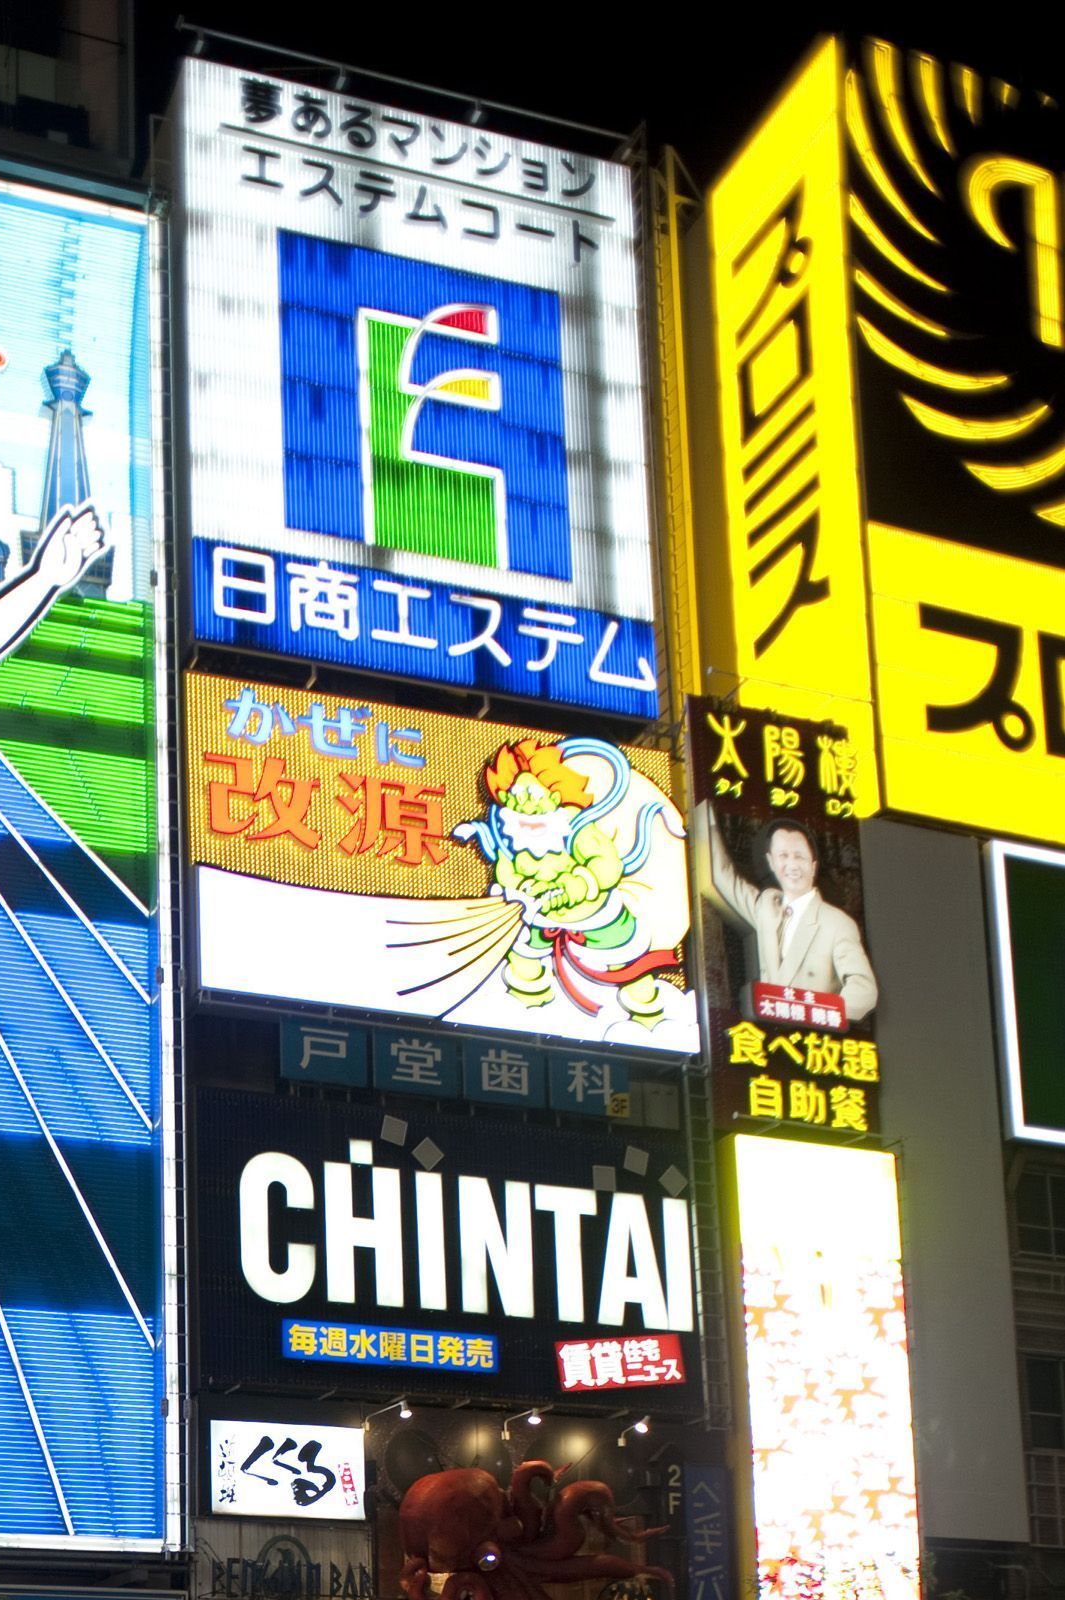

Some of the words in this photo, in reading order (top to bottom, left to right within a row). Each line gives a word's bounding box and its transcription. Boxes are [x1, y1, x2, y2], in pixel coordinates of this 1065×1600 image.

[240, 76, 597, 198] 夢あるマンション
[241, 145, 600, 263] エステムコート
[731, 175, 831, 660] プロミス
[212, 547, 658, 692] 日商エステム
[226, 687, 426, 769] かぜに
[203, 751, 449, 866] 改源
[299, 1026, 614, 1106] 戸堂歯科
[728, 1021, 880, 1083] 食べ放題
[749, 1074, 869, 1133] 自助餐
[239, 1140, 694, 1331] CHINTAI
[288, 1324, 495, 1369] 毎週水曜日発売
[240, 1435, 337, 1507] くくる
